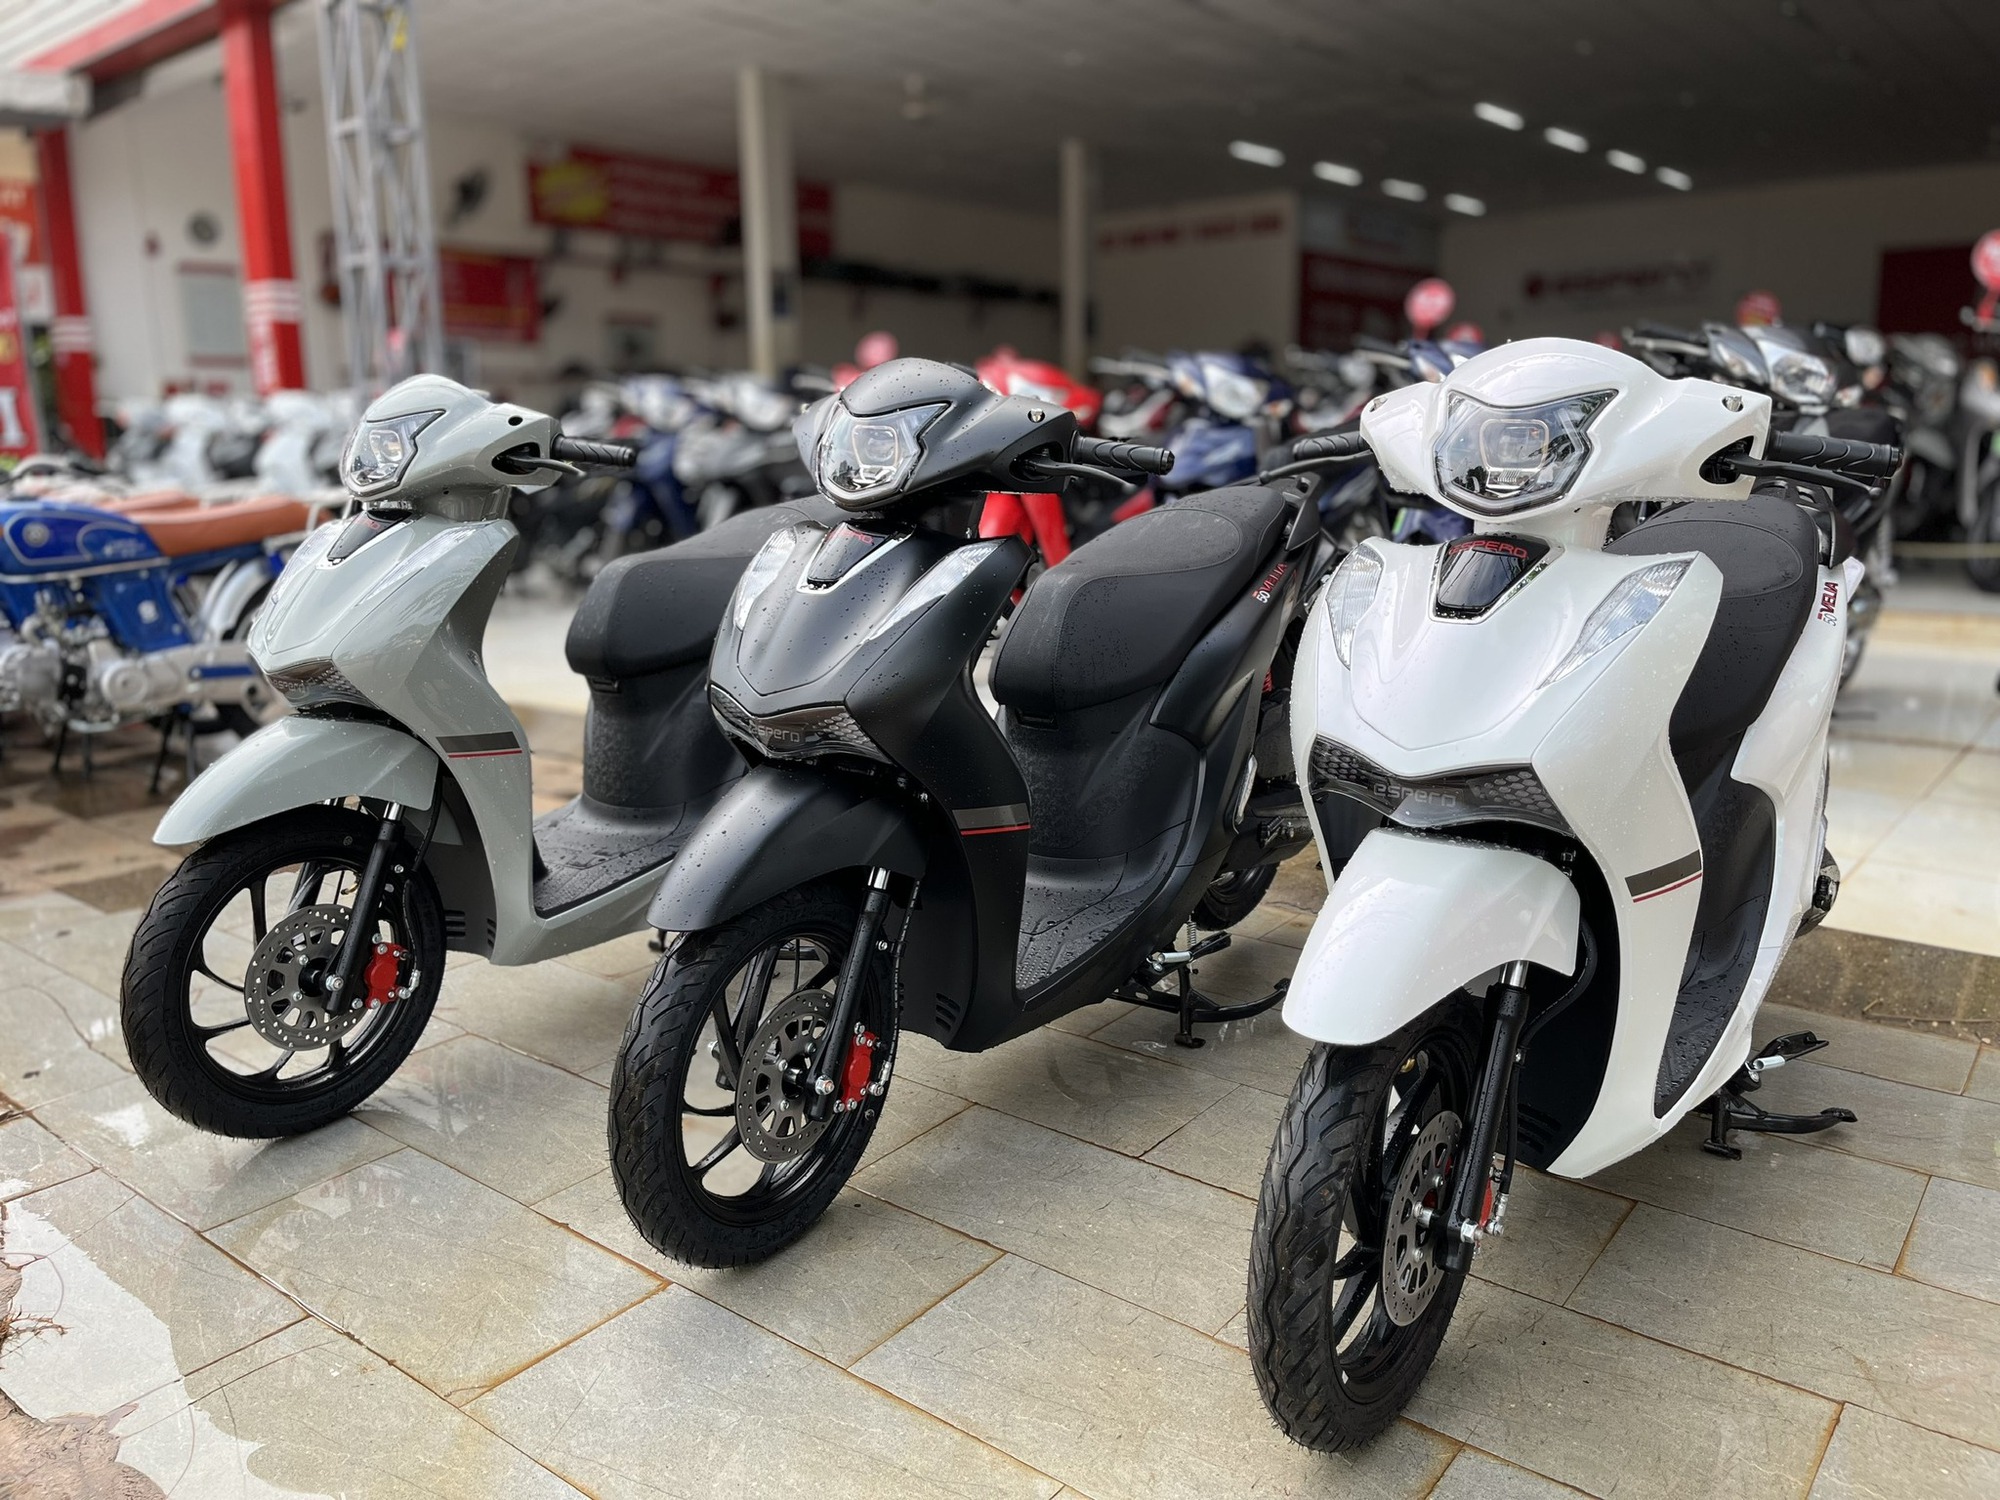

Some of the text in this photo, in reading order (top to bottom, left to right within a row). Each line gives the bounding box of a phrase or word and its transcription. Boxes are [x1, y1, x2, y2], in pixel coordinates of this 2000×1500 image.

[1448, 540, 1528, 559] ESPERO
[1819, 581, 1839, 627] 50 VELIA
[1373, 782, 1457, 808] espero
